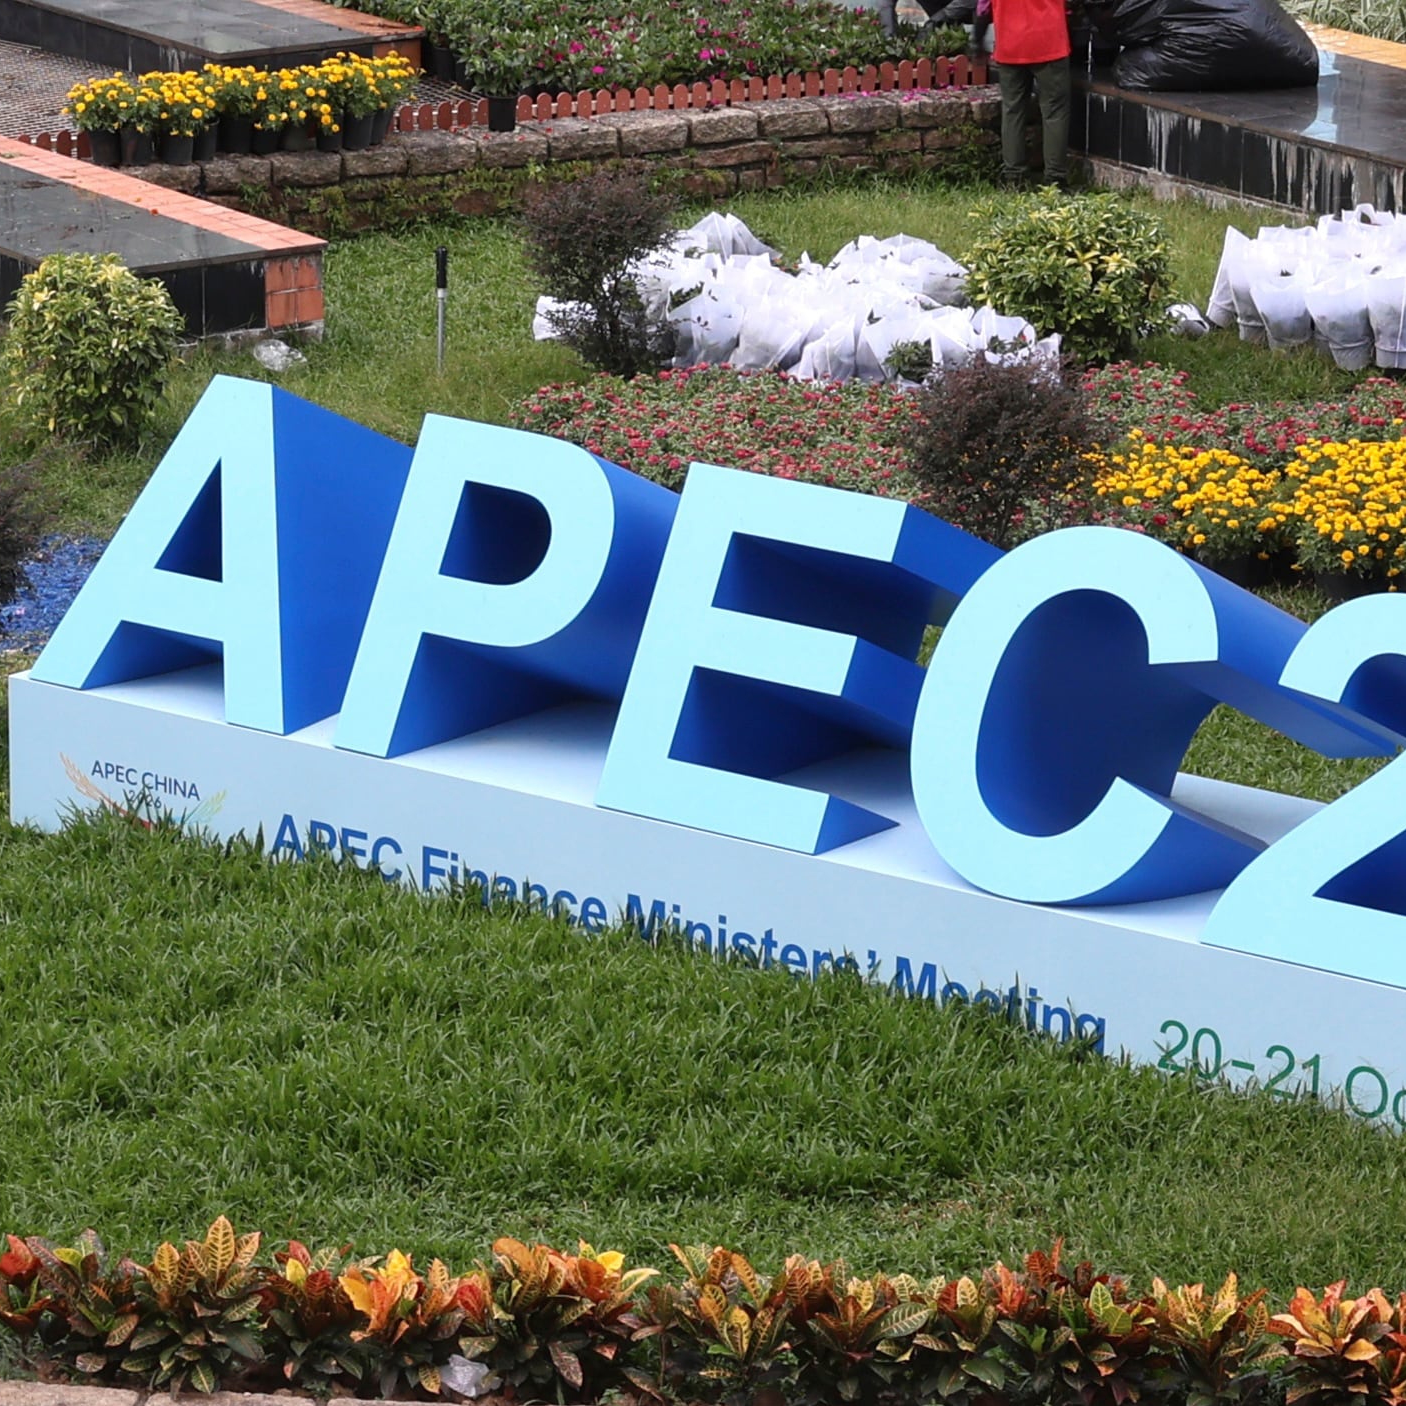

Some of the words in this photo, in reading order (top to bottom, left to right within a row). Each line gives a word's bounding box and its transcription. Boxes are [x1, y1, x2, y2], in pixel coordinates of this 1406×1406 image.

[91, 760, 138, 786] APEC
[142, 772, 200, 801] CHINA
[270, 813, 403, 883] APEC
[422, 845, 607, 933] Finance
